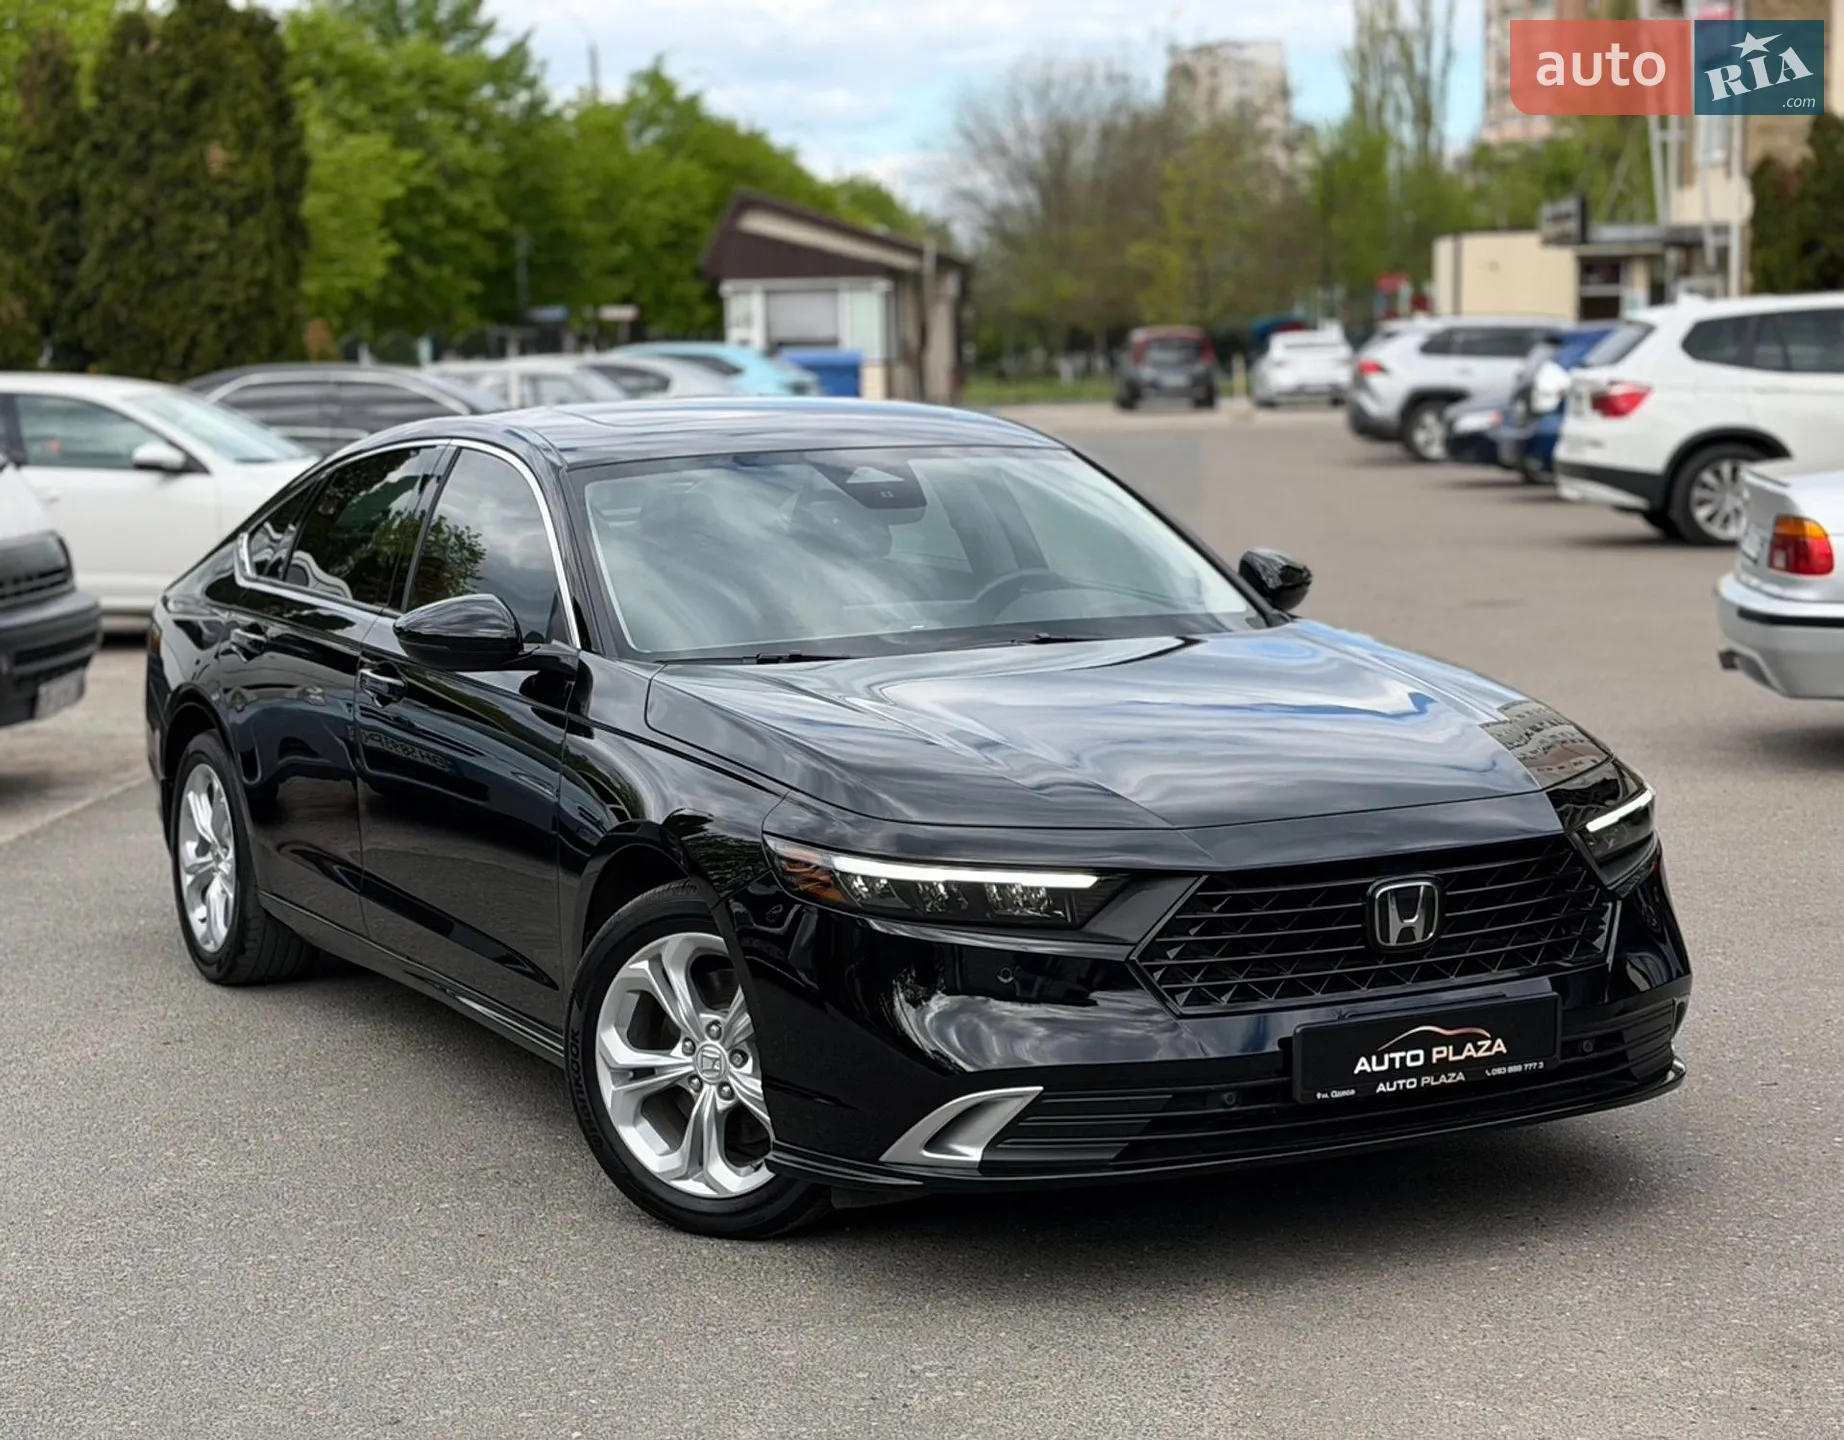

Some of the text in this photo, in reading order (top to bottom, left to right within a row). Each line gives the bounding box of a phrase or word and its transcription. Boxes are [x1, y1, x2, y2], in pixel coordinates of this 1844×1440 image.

[1354, 1038, 1507, 1075] AUTO PLAZA
[1523, 1061, 1538, 1071] 777
[1376, 1071, 1466, 1094] AUTO PLAZA
